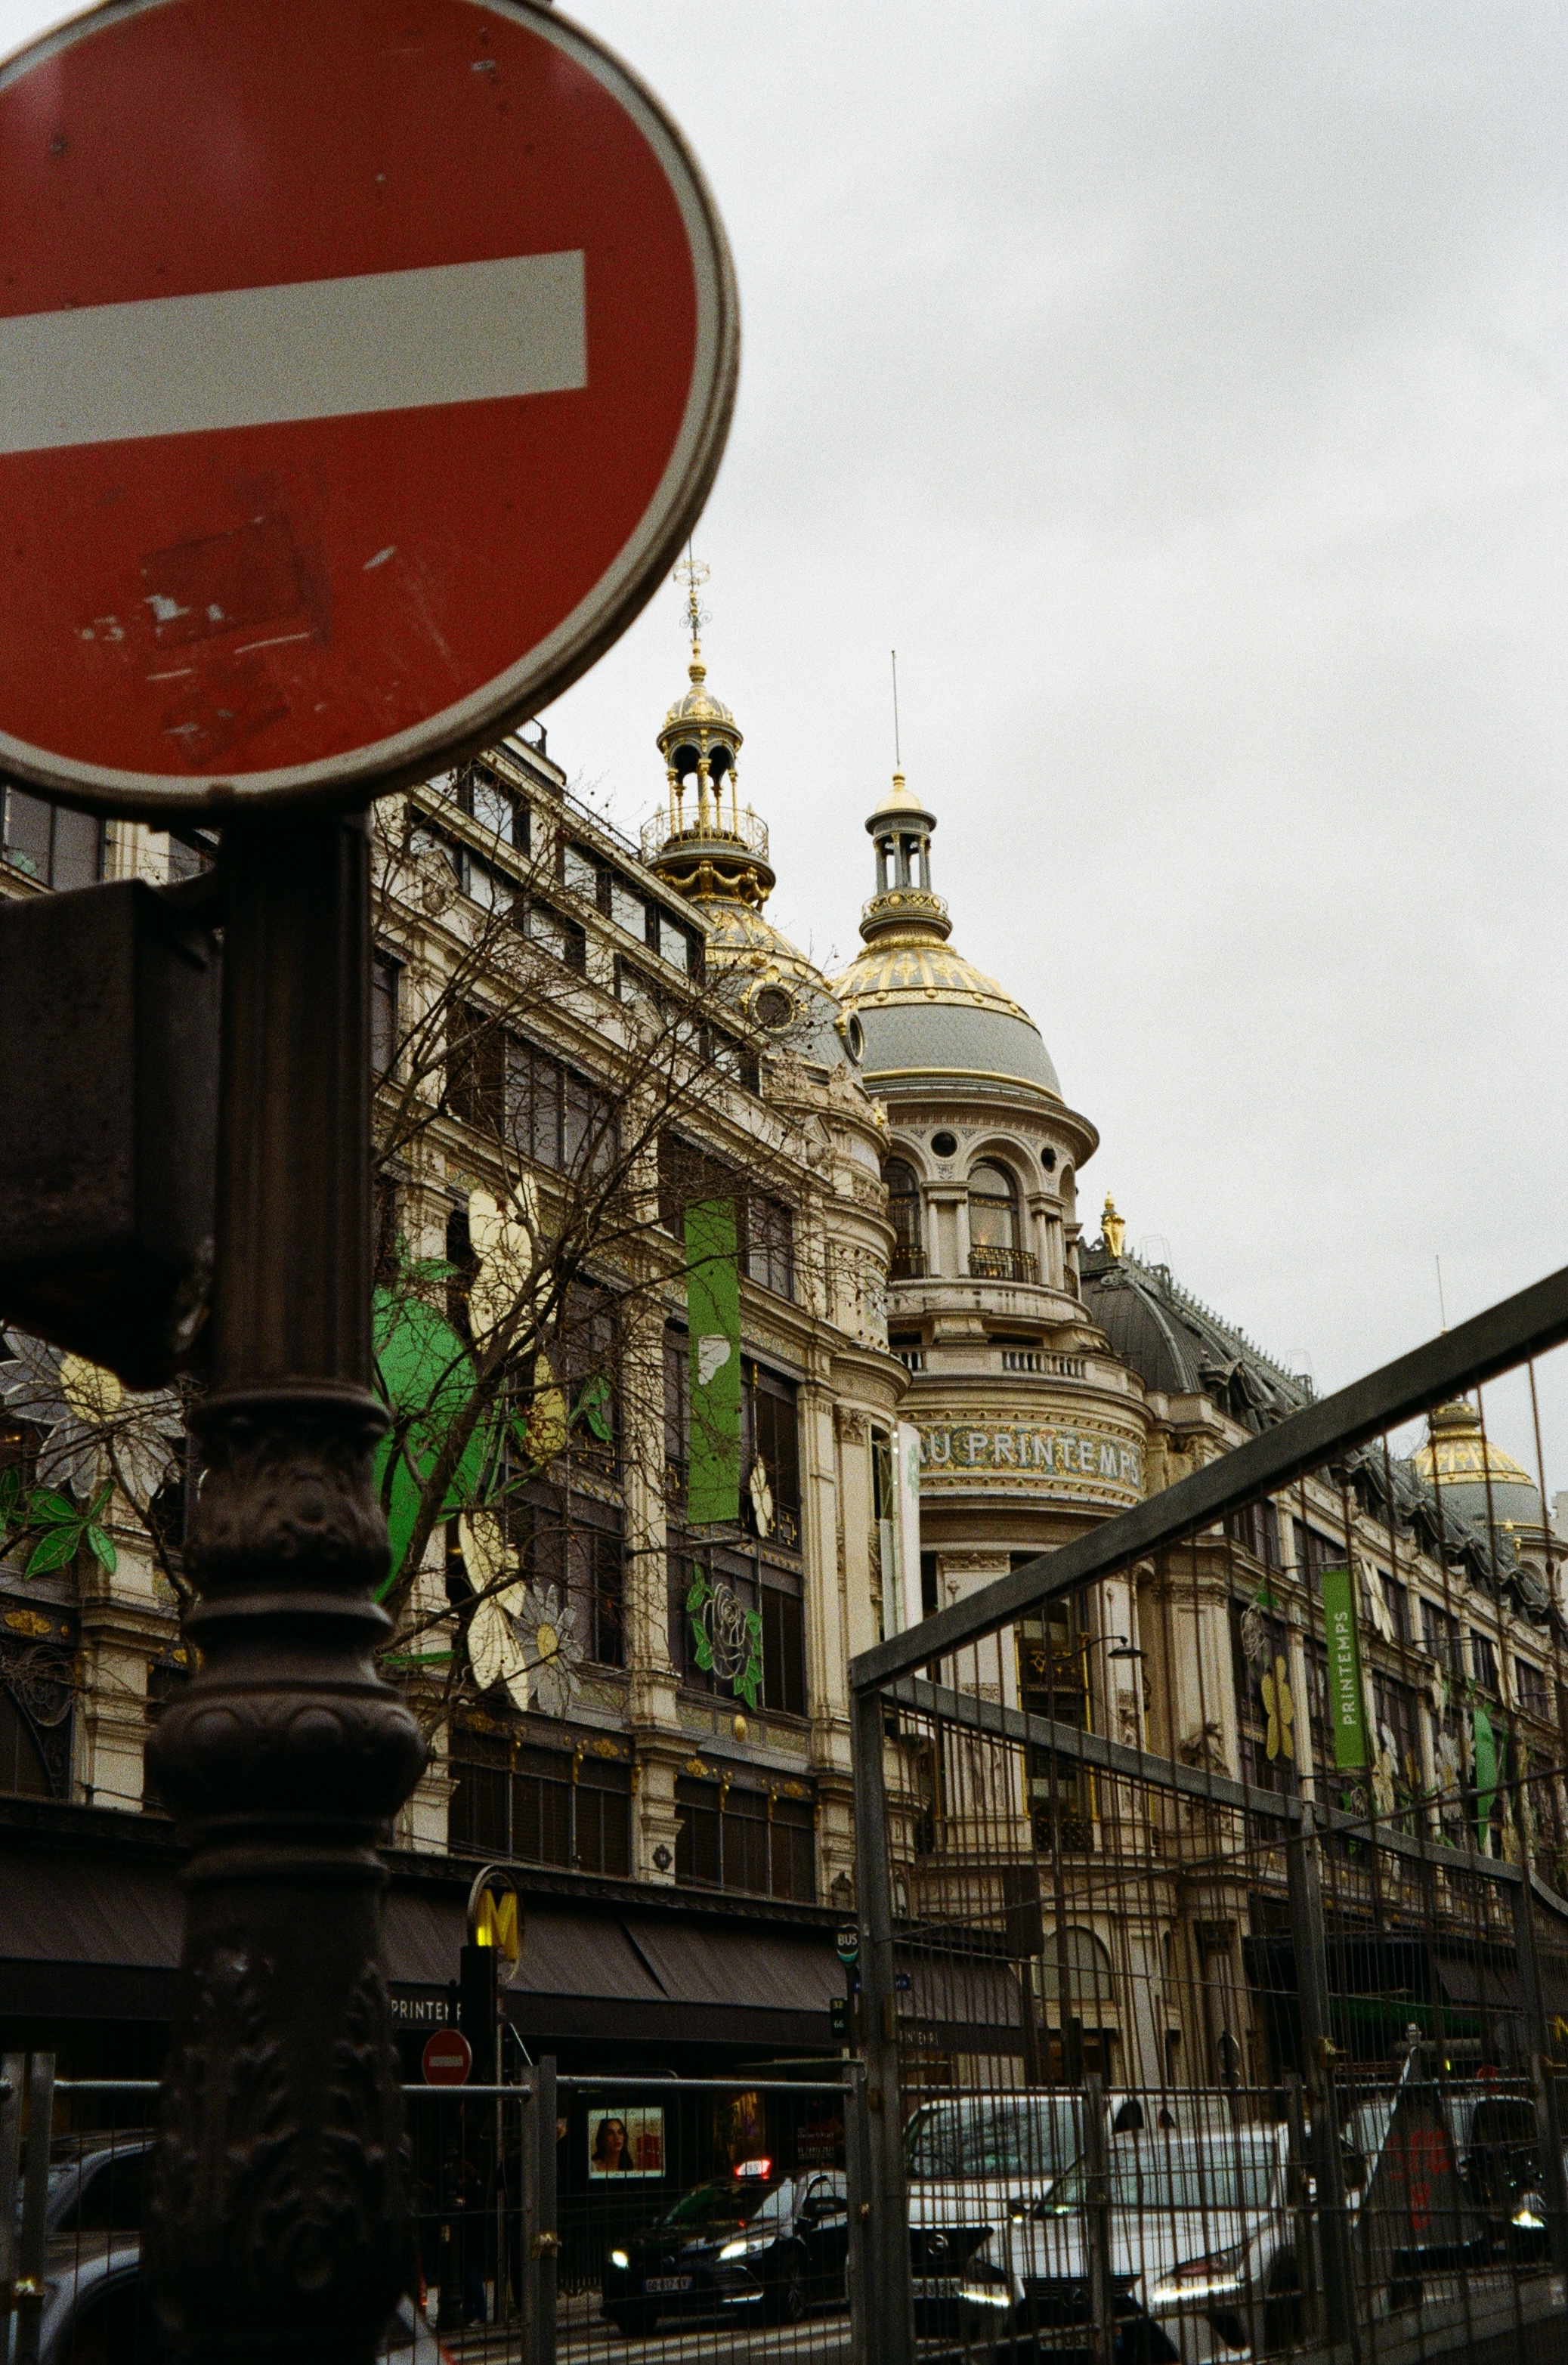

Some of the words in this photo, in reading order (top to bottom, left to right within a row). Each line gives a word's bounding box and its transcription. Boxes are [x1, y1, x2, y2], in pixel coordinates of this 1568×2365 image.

[968, 1433, 1140, 1488] PRINTEMPS
[1335, 1610, 1358, 1725] PRINTEMPS
[476, 1888, 518, 1962] M
[837, 1933, 858, 1946] BUS
[833, 2019, 845, 2029] 66
